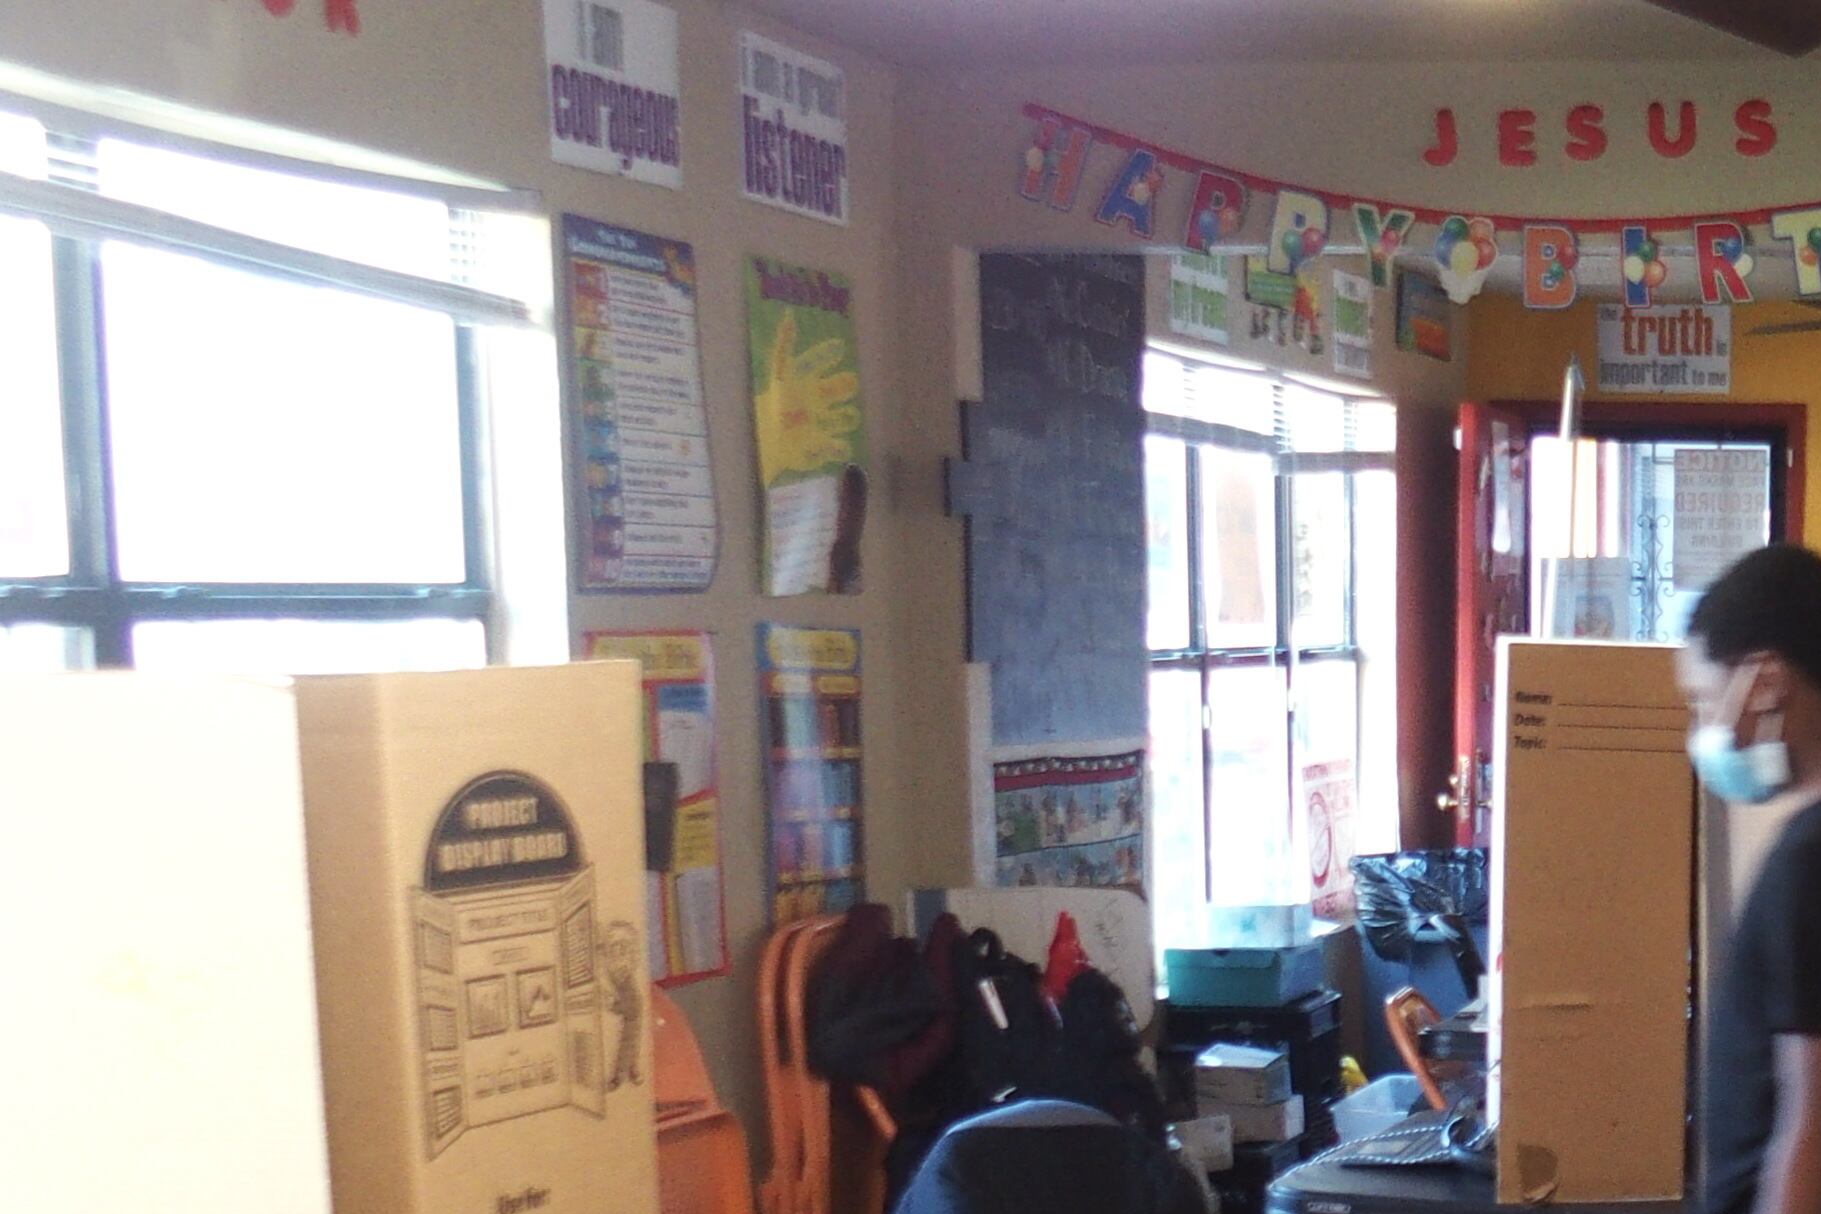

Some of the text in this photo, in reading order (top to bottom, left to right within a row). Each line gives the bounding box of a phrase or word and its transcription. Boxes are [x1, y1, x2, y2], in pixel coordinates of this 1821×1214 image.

[551, 64, 680, 170] courageous
[1421, 98, 1778, 167] JESUS
[742, 94, 847, 218] listener
[1018, 112, 1415, 288] HAPPY
[1622, 307, 1713, 356] truth
[1600, 359, 1727, 387] important to me
[1514, 714, 1546, 727] Date:
[1514, 736, 1546, 749] Topic:
[467, 797, 539, 830] PROJECT
[439, 831, 568, 873] DISPLAY BOARD
